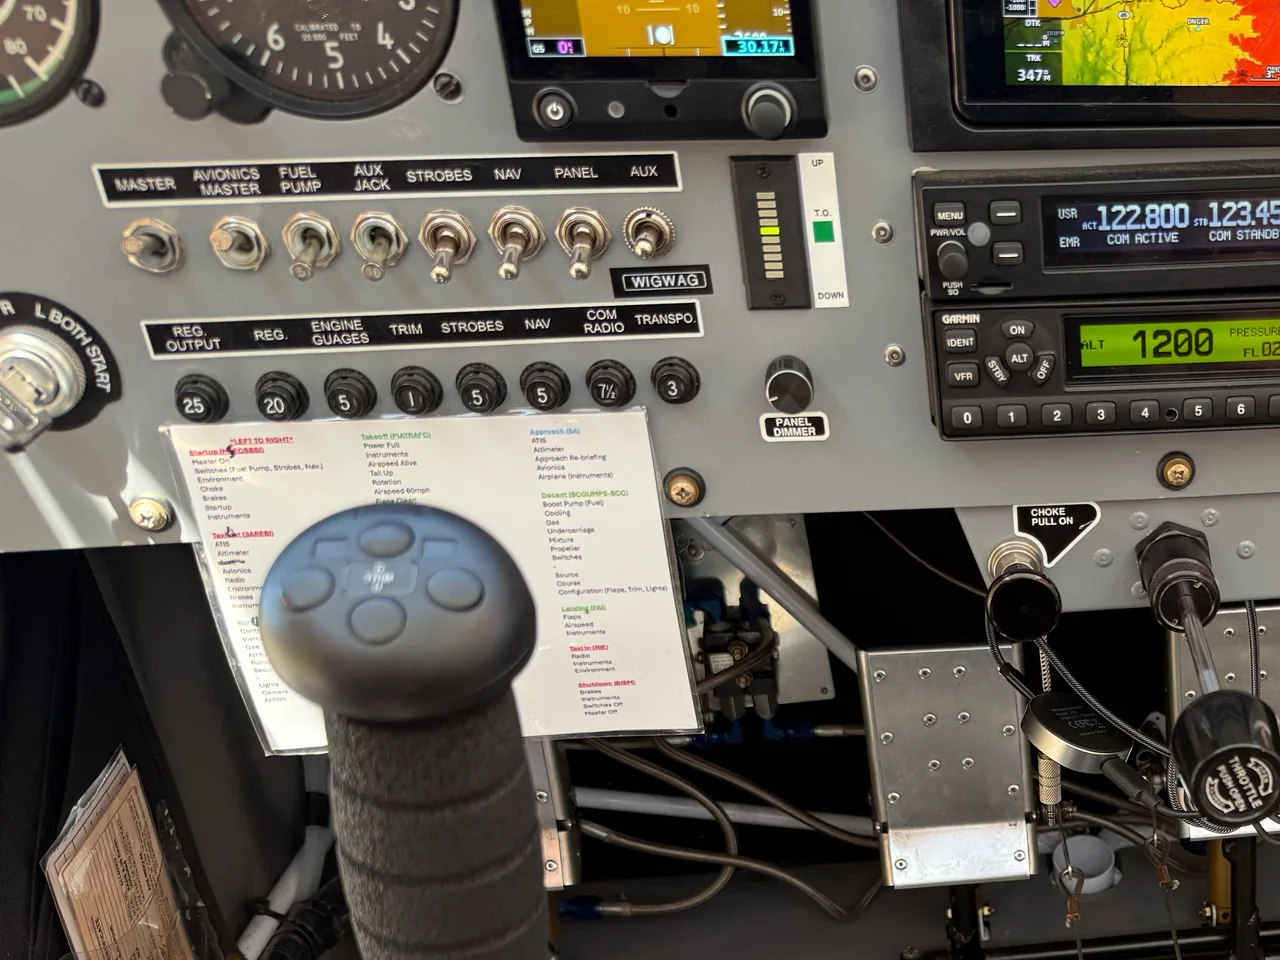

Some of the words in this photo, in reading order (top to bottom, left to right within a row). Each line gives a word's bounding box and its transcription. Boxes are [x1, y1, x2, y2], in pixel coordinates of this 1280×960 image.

[22, 5, 47, 21] 70
[266, 23, 285, 51] 6
[377, 21, 394, 49] 4
[3, 37, 28, 55] 80
[324, 41, 344, 69] 5
[1026, 54, 1042, 62] TRK
[811, 159, 824, 168] UP
[193, 167, 260, 182] AVIONICS
[279, 166, 317, 179] FUEL
[353, 164, 384, 177] AUX
[406, 169, 473, 183] STROBES
[493, 168, 522, 180] NAV
[554, 166, 599, 179] PANEL
[630, 165, 658, 177] AUX
[114, 176, 177, 192] MASTER
[200, 181, 262, 197] MASTER
[280, 179, 322, 194] PUMP
[354, 178, 391, 192] JACK
[814, 209, 831, 218] T.O.
[938, 212, 964, 221] MENU
[1057, 207, 1078, 220] USR
[1082, 222, 1097, 231] ACT
[1097, 203, 1190, 231] 122.800
[1193, 218, 1209, 227] STB
[930, 228, 967, 237] PWR/VOL
[1059, 236, 1080, 248] EMR
[1107, 234, 1130, 246] COM
[1135, 232, 1179, 245] ACTIVE
[1209, 230, 1232, 242] COM
[631, 274, 699, 288] WIGWAG
[818, 292, 844, 300] DOWN
[587, 309, 617, 321] COM
[634, 312, 696, 326] TRANSPO.
[942, 314, 980, 324] GARMIN
[310, 319, 363, 333] ENGINE
[388, 323, 423, 336] TRIM
[441, 320, 504, 334] STROBES
[524, 318, 551, 330] NAV
[583, 322, 625, 335] RADIO
[1010, 326, 1025, 335] ON
[172, 325, 207, 338] REG.
[253, 329, 288, 342] REG.
[165, 338, 221, 352] OUTPUT
[312, 333, 369, 346] GUAGES
[947, 338, 974, 347] IDENT
[1081, 340, 1105, 350] ALT
[1133, 328, 1213, 359] 1200
[1244, 348, 1259, 358] FL
[48, 308, 92, 347] BOTH
[86, 343, 111, 393] START
[1011, 354, 1028, 363] ALT
[988, 360, 1007, 383] STBY
[1037, 360, 1050, 379] OFF
[954, 373, 973, 381] VFR
[667, 381, 678, 396] 3
[183, 398, 204, 414] 25
[263, 398, 285, 414] 20
[775, 417, 812, 428] PANEL
[530, 428, 565, 436] Approach
[773, 426, 816, 437] DIMMER
[368, 460, 399, 468] Airspeed
[538, 473, 567, 481] Airplane
[1031, 507, 1066, 516] CHOKE
[1031, 517, 1057, 526] PULL
[1059, 517, 1073, 525] ON
[547, 527, 595, 535] Undercarriage
[558, 588, 603, 596] Configuration
[1216, 764, 1235, 789] PUSH
[1229, 756, 1263, 809] THROTTLE
